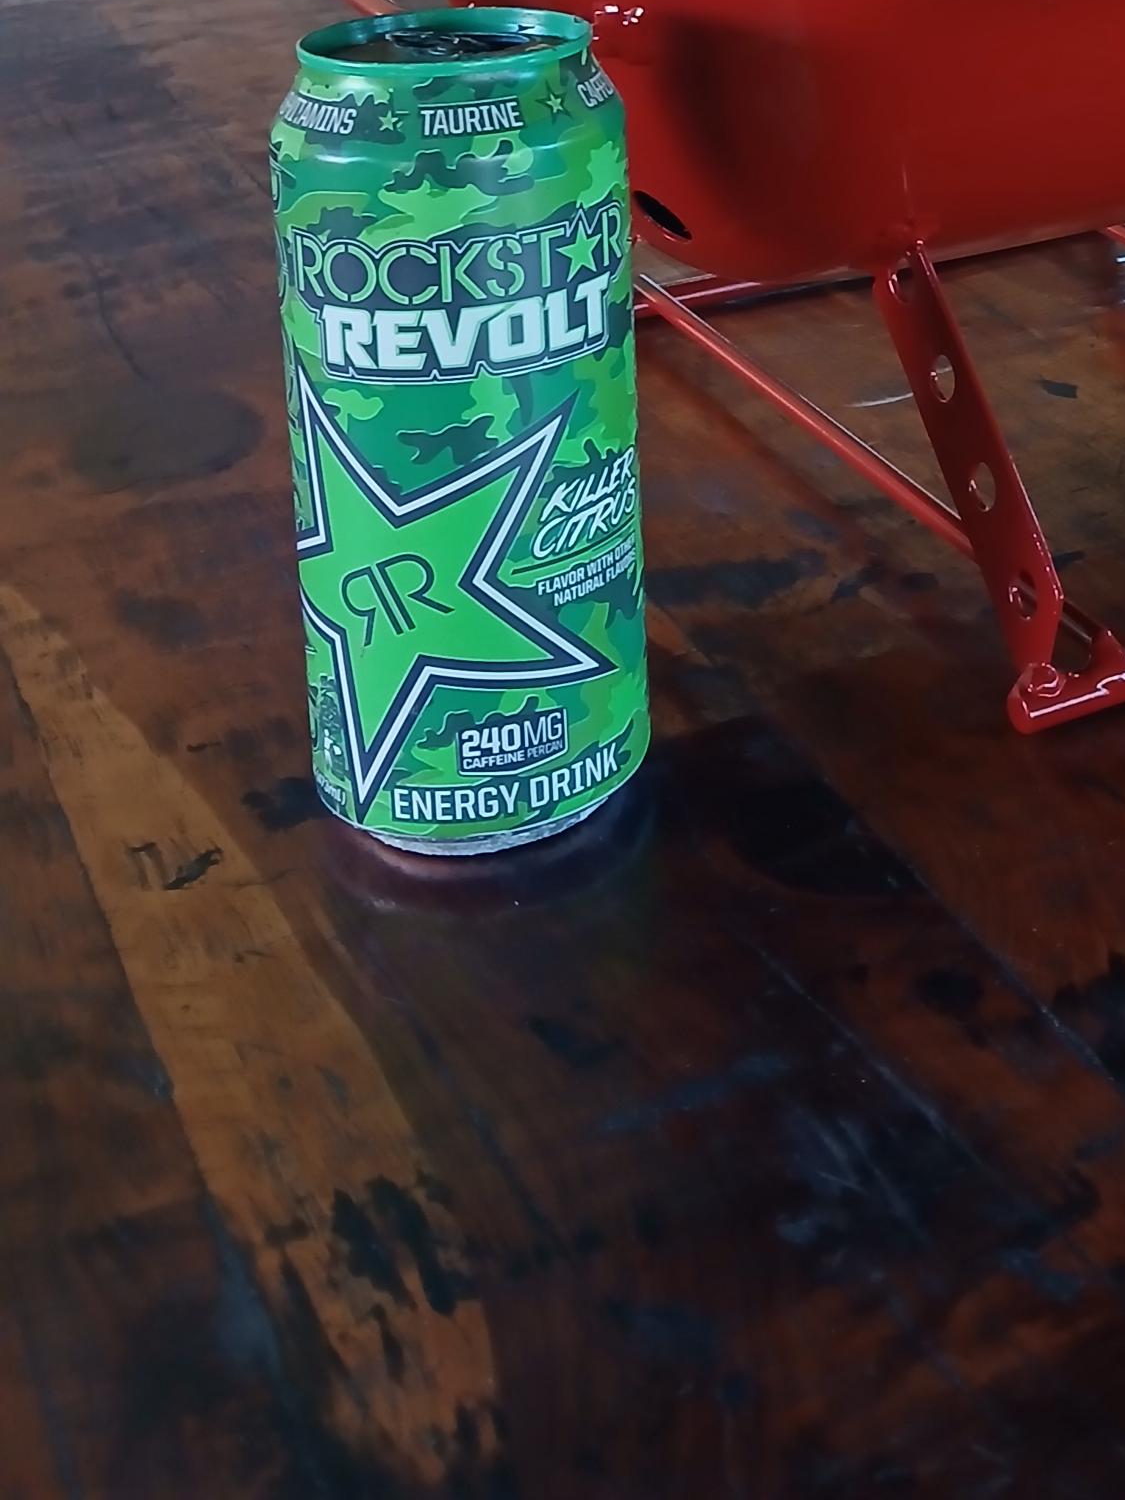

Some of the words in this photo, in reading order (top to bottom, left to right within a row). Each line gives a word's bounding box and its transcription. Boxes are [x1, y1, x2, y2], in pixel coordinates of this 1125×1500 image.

[421, 101, 524, 136] TAURINE
[322, 274, 611, 371] REVOLT
[540, 447, 634, 522] KILLER
[533, 477, 636, 558] CITRUS
[538, 567, 585, 596] FLAVOR
[586, 551, 614, 577] WITH
[554, 573, 605, 606] NATURAL
[394, 781, 521, 822] ENERGY
[529, 742, 619, 809] DRINK
[463, 751, 526, 770] CAFFEINE
